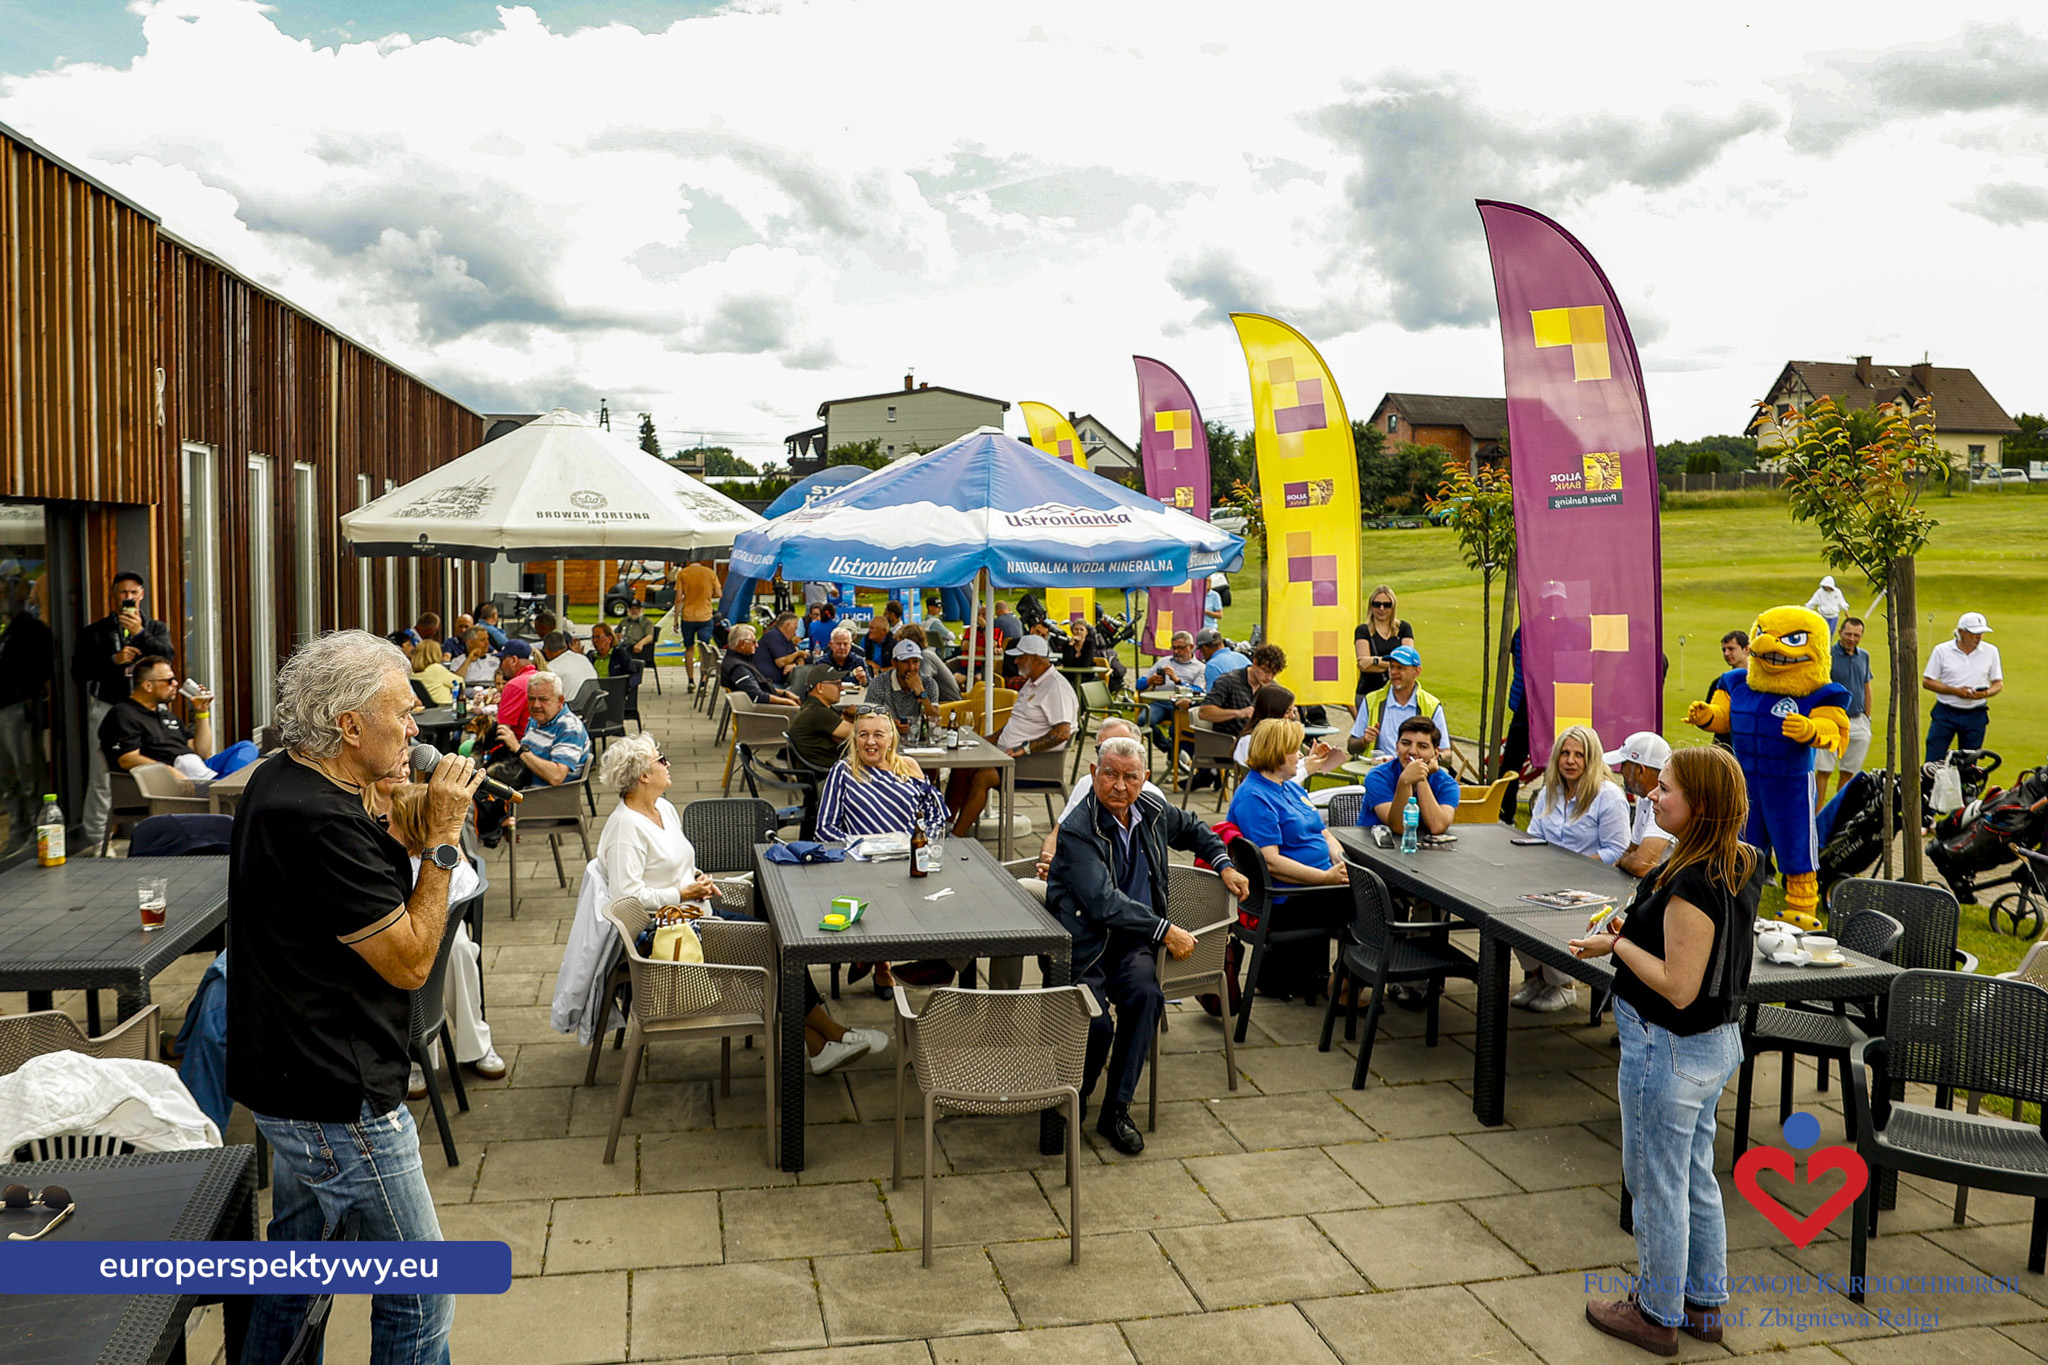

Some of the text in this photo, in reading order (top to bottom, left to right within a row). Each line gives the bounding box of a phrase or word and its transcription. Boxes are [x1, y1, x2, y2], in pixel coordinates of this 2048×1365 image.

[536, 511, 651, 520] BROWAR FORTUNA
[1004, 512, 1132, 527] Ustronianka
[827, 555, 937, 578] Ustronianka
[1006, 560, 1068, 574] NATURALNA
[1071, 562, 1105, 573] WODA
[1108, 559, 1174, 572] MINERALNA
